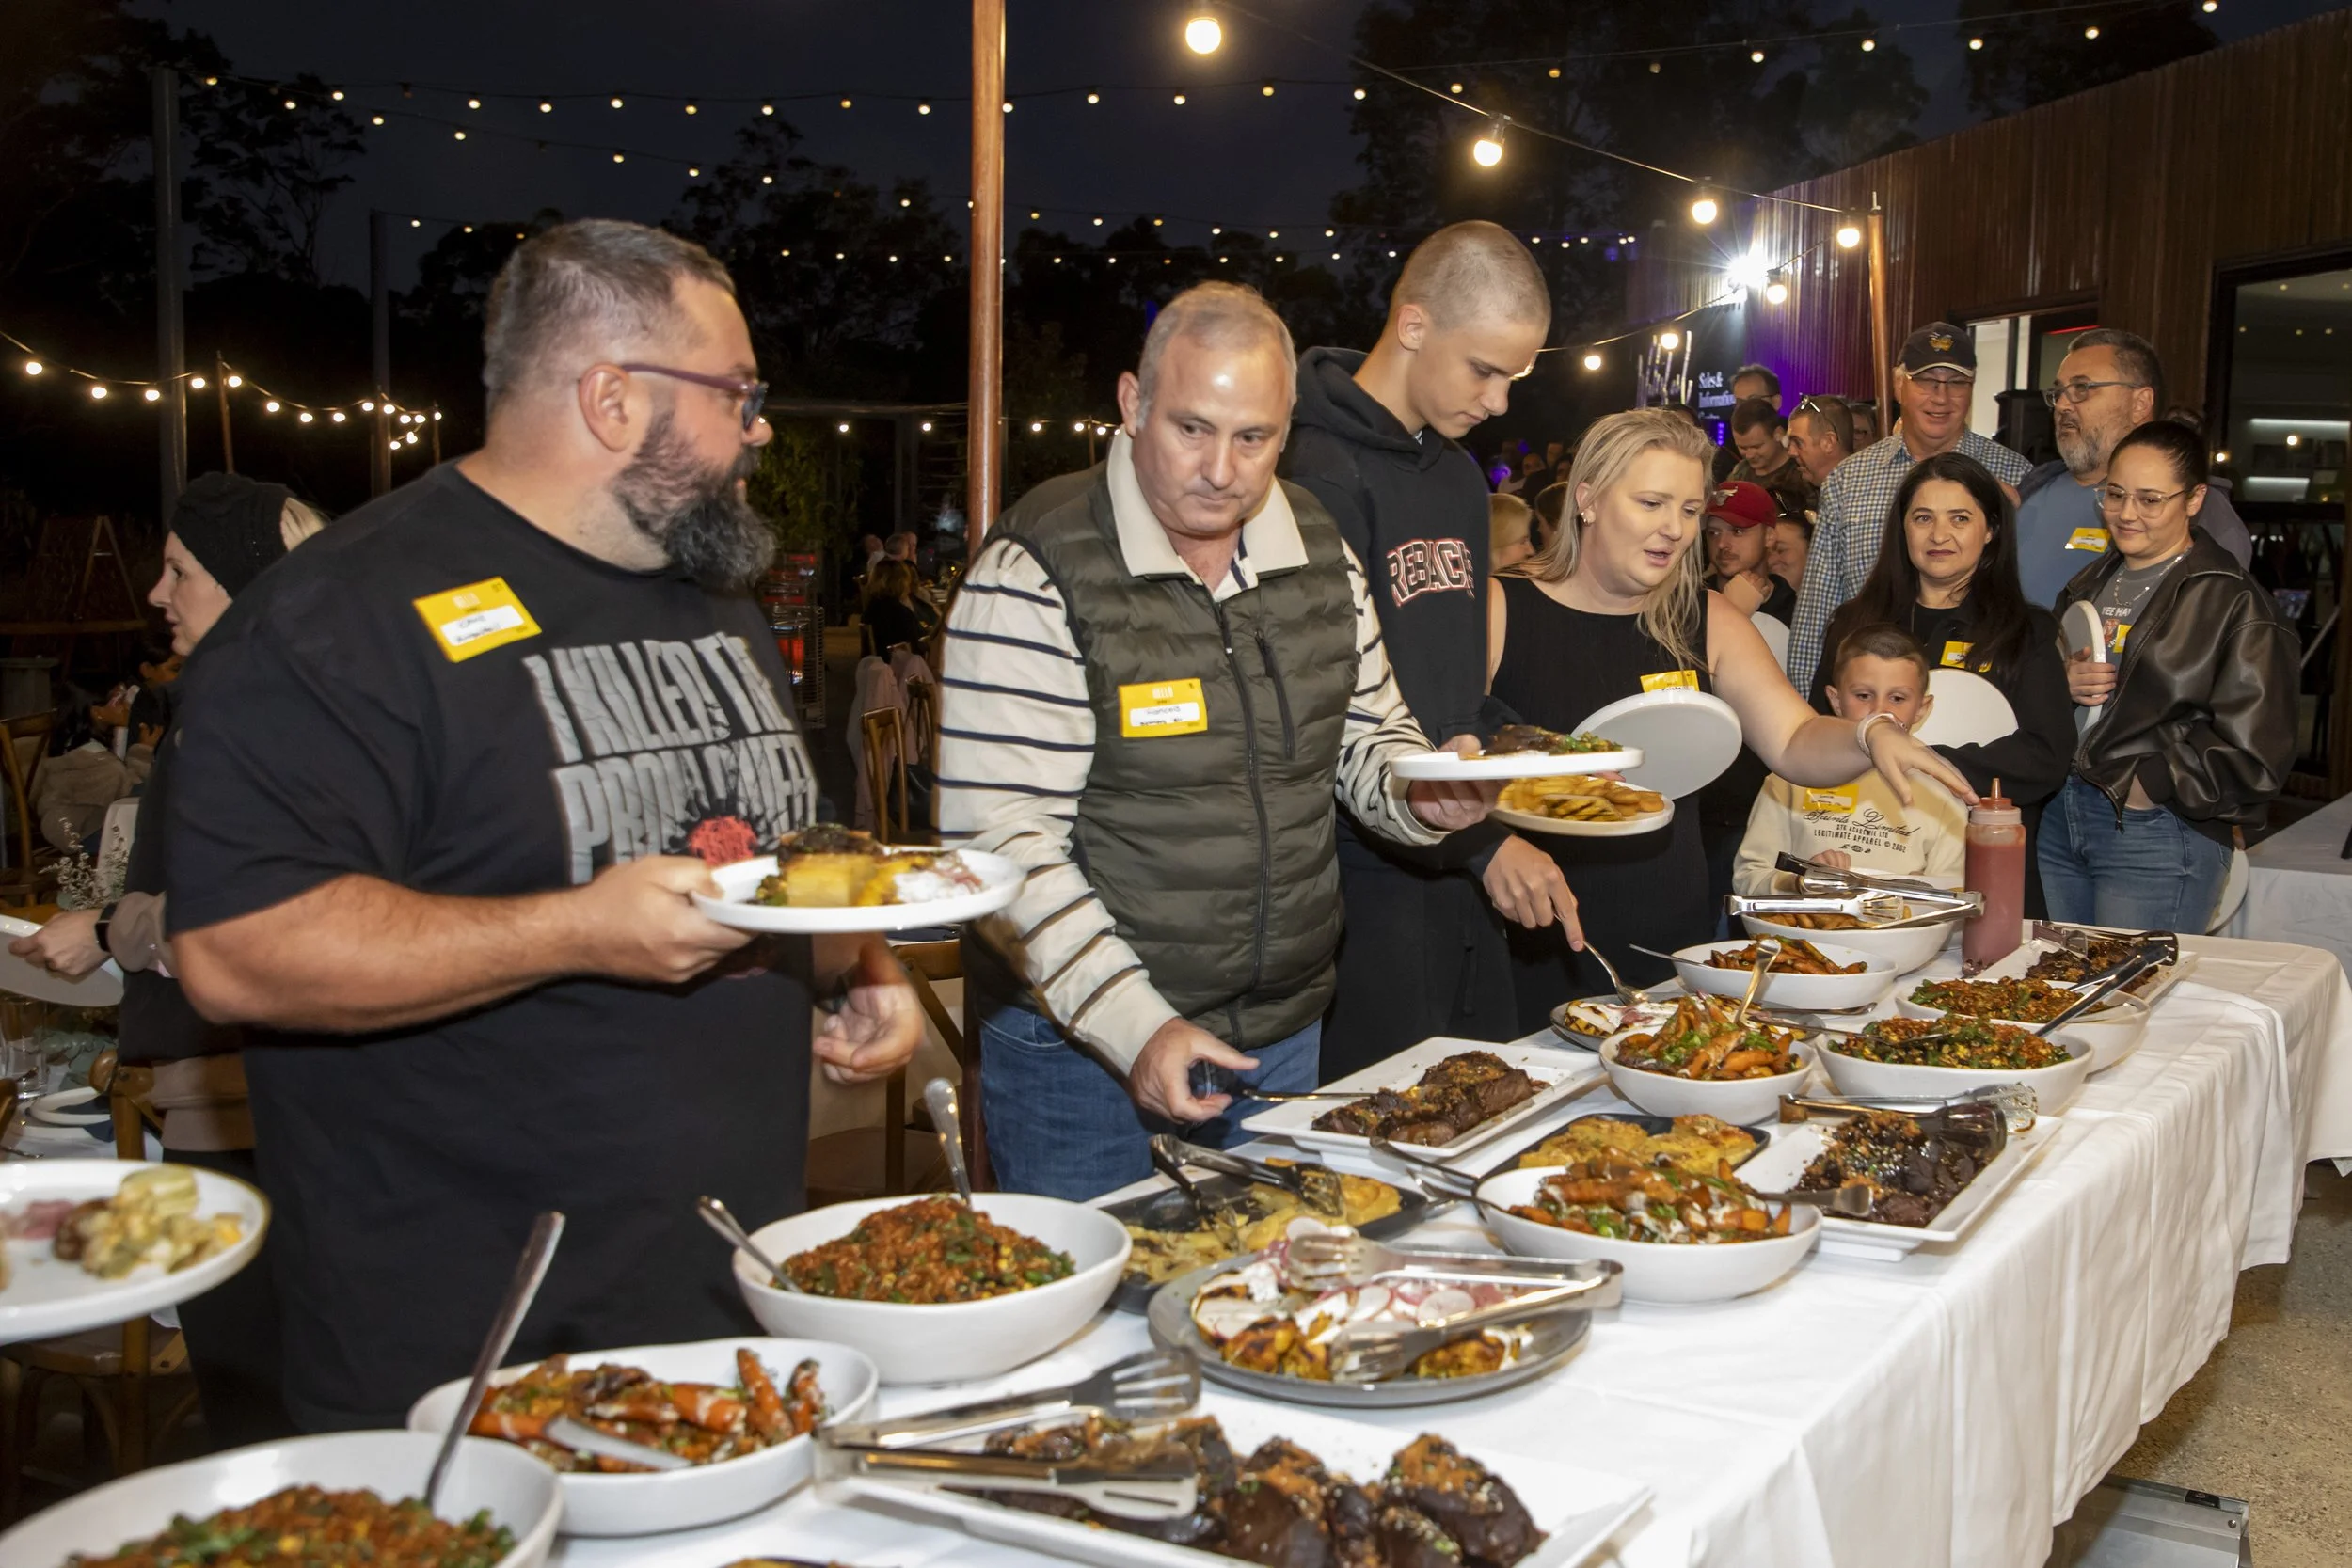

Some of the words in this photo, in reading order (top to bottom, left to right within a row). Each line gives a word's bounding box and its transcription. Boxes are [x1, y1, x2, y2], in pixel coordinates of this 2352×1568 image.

[522, 654, 584, 764] I
[549, 640, 733, 755] KILLED
[1814, 829, 1851, 840] LEGITIMATE
[1853, 833, 1882, 847] APPAREL
[1851, 807, 1922, 837] Limited
